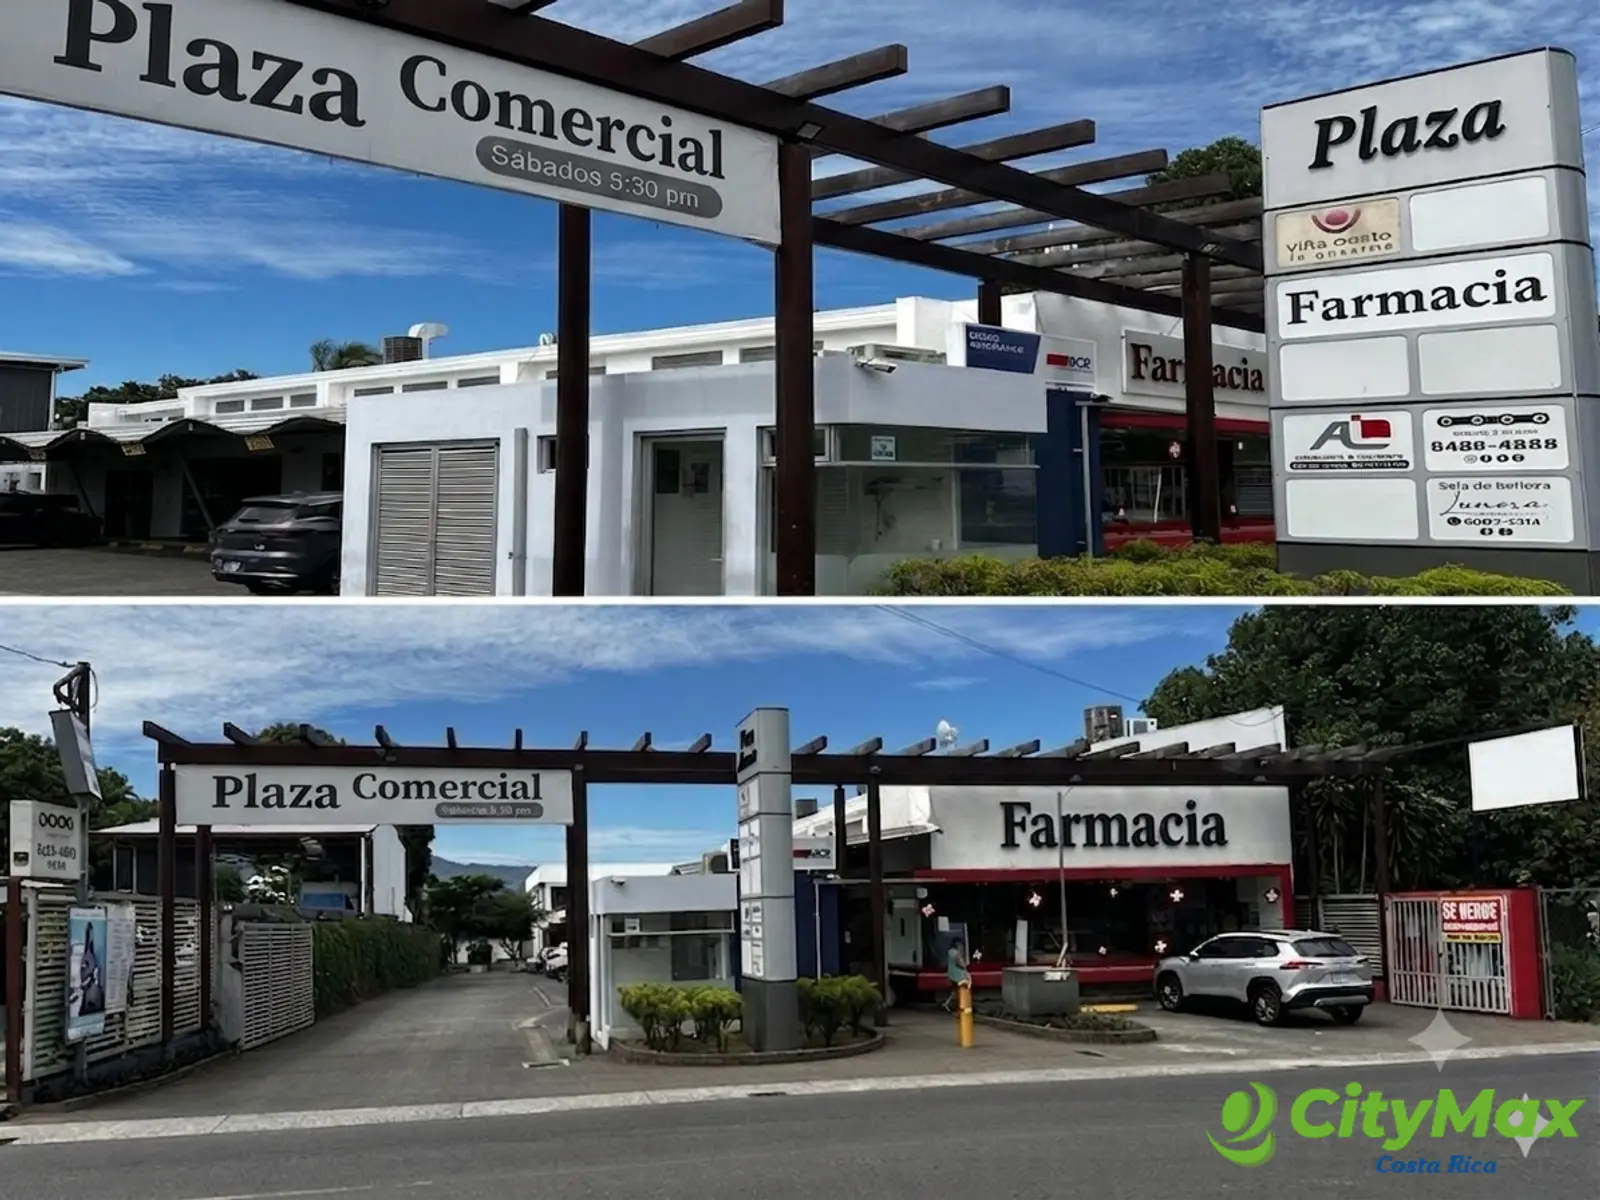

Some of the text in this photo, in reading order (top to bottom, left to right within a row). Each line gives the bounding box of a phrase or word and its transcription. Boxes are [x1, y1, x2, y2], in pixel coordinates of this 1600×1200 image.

[53, 0, 725, 180] Plaza Comercial
[1308, 98, 1506, 170] Plaza
[491, 144, 602, 187] Sábados
[1286, 269, 1547, 326] Farmacia
[1130, 342, 1265, 392] Faracia
[212, 773, 543, 809] Plaza Comercial
[1000, 800, 1229, 849] Farmacia
[1442, 902, 1458, 920] SE
